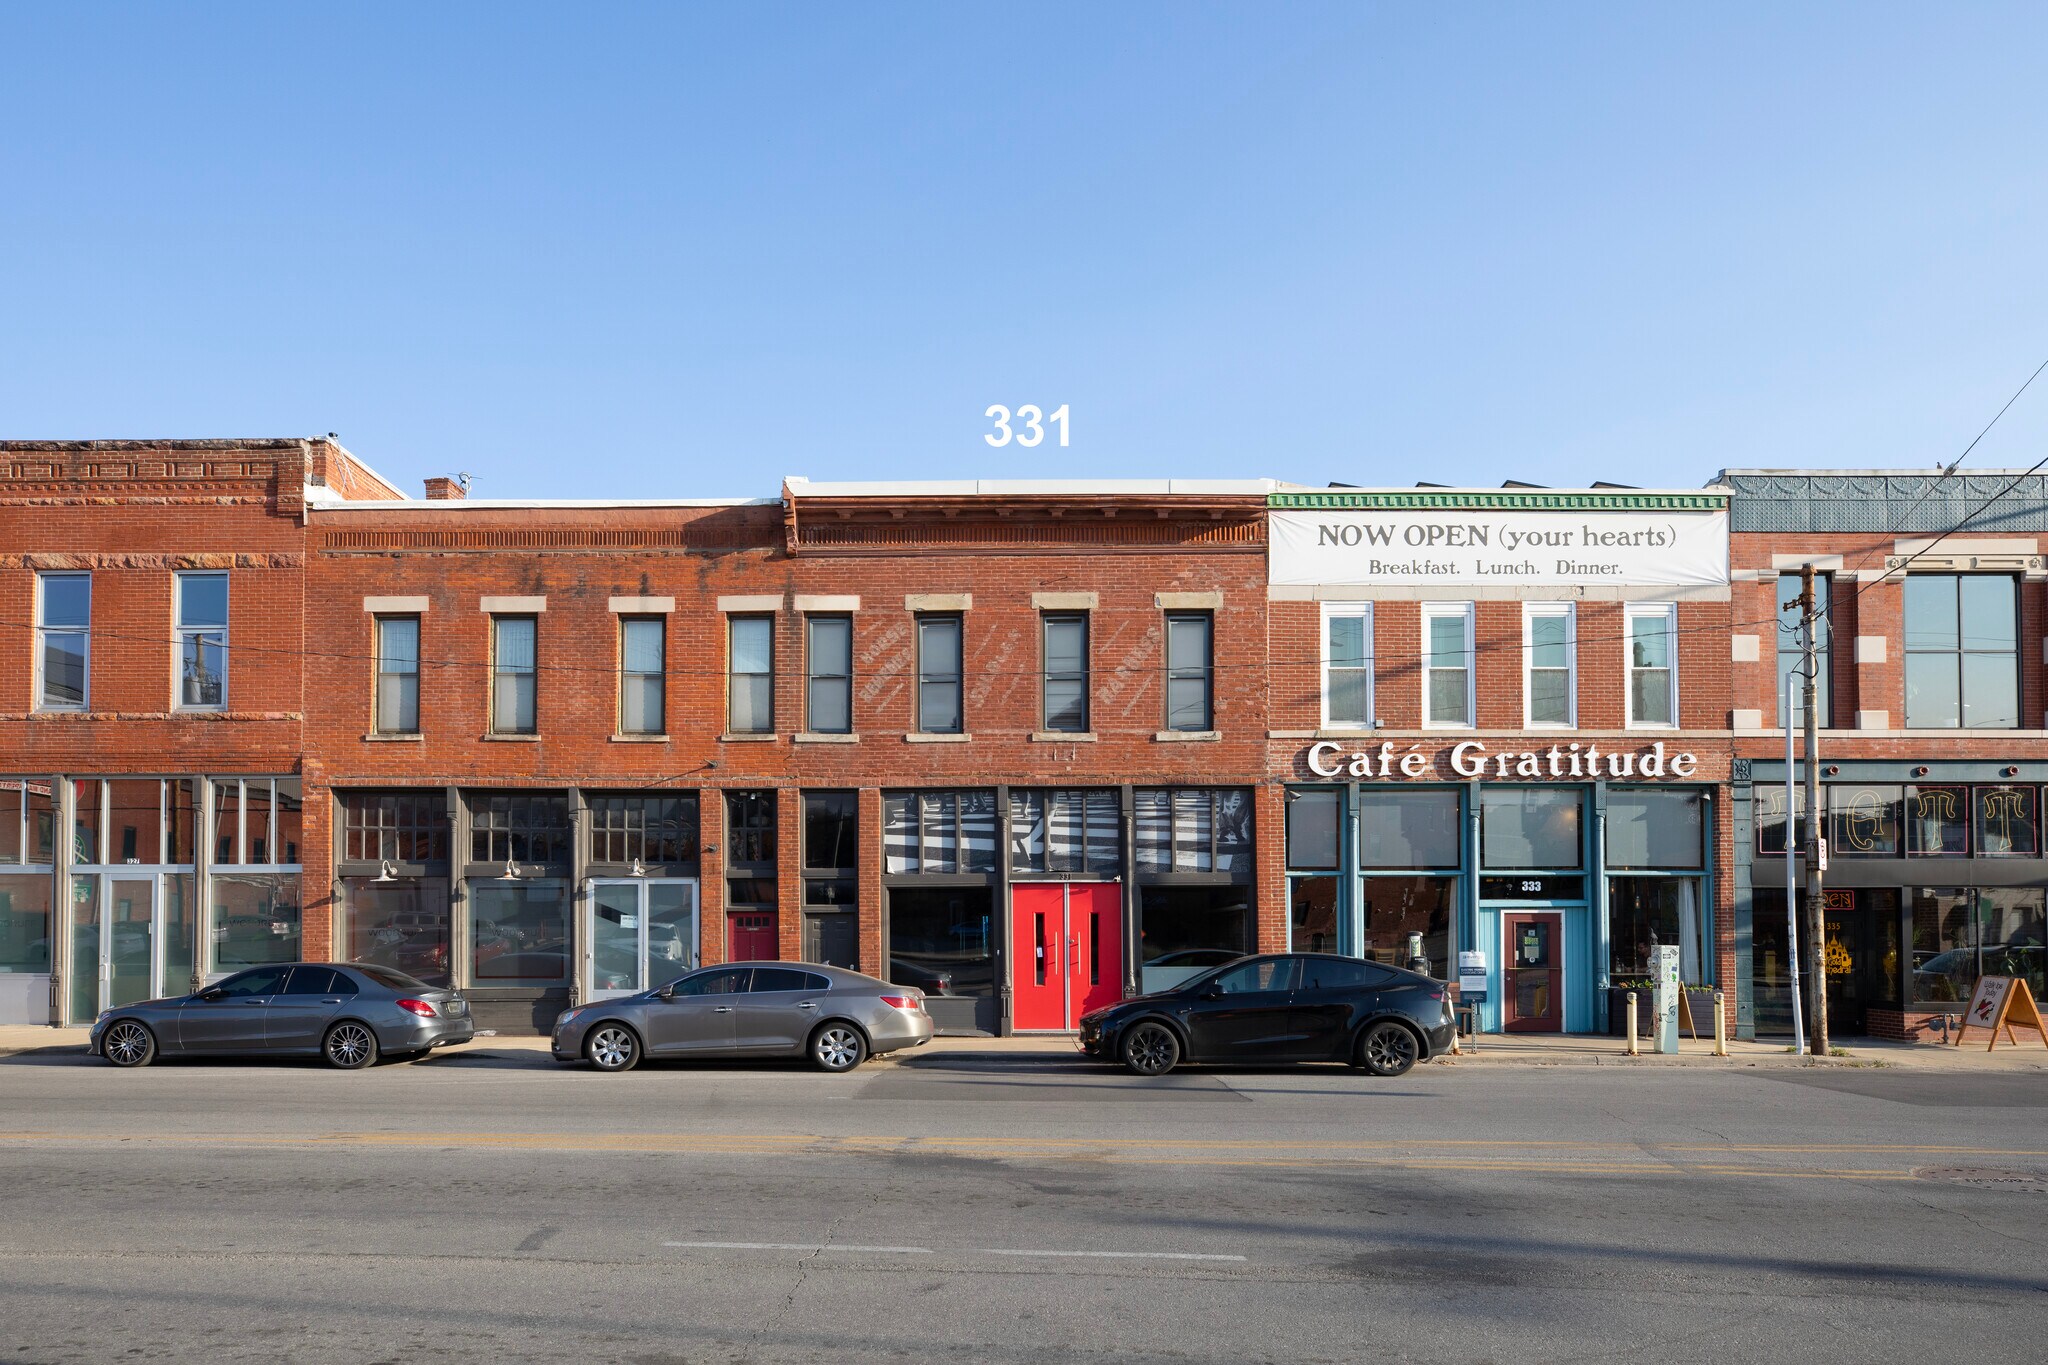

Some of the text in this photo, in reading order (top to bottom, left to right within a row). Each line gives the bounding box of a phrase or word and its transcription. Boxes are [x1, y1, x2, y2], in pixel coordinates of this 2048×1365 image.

[1317, 523, 1678, 551] NOW OPEN (your hearts)
[1368, 559, 1623, 575] Breakfast. Lunch. Dinner.
[1307, 741, 1427, 778] Café
[1450, 741, 1698, 778] Gratitude
[1521, 880, 1542, 892] 333
[1822, 893, 1852, 907] PEN
[1826, 922, 1841, 930] 335
[1825, 965, 1852, 976] thedral
